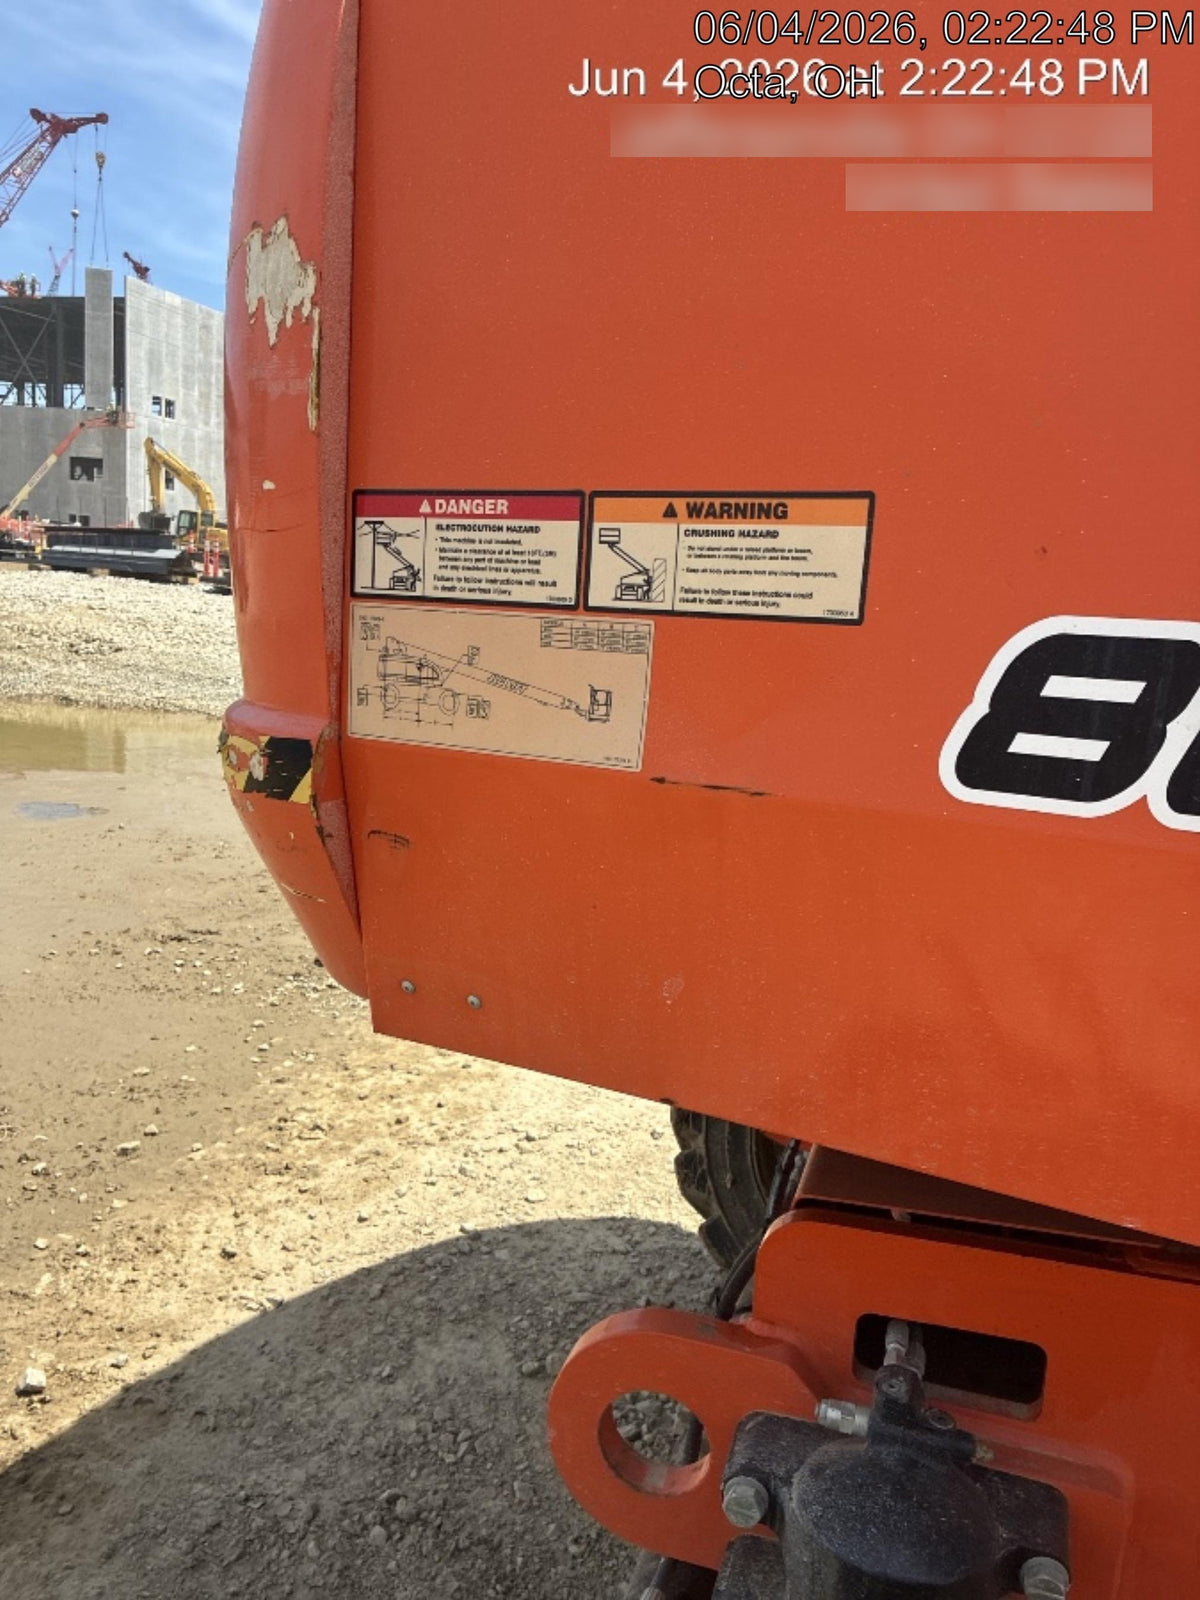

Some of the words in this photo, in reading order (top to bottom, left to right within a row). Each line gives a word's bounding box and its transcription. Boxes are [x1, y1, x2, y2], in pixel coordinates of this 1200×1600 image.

[434, 499, 509, 515] DANGER
[685, 501, 788, 520] WARNING
[435, 523, 504, 533] ELECTROCUTION
[506, 525, 541, 534] HAZARD
[684, 529, 735, 538] CRUSHING
[738, 529, 780, 539] HAZARD
